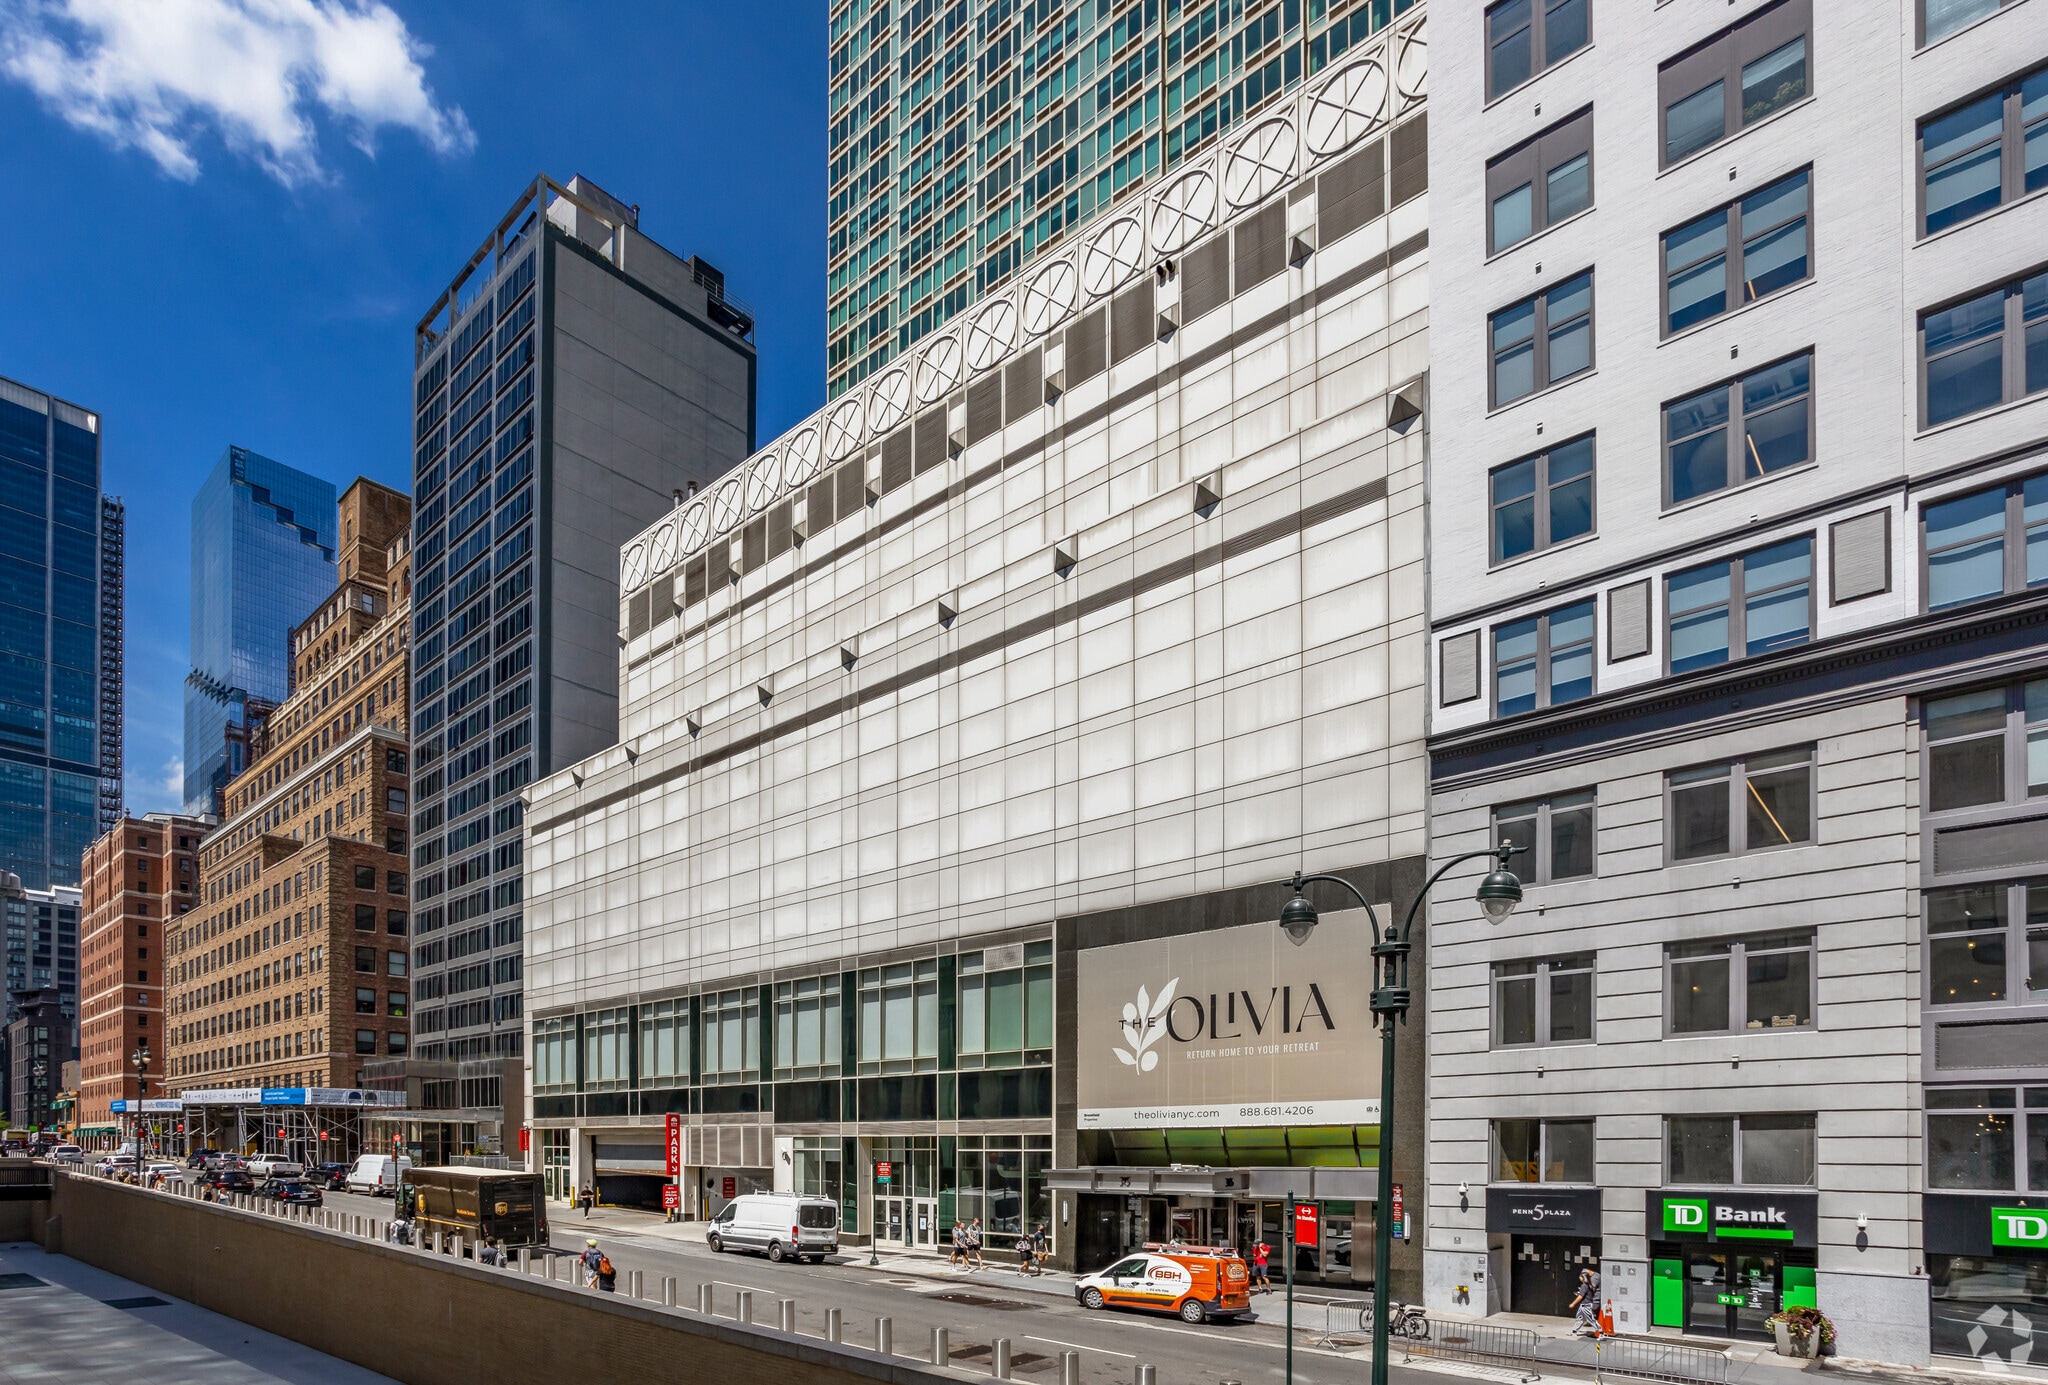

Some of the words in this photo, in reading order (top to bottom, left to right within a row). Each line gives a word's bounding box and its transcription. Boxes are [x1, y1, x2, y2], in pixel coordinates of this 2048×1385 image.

[1118, 1017, 1156, 1030] THE
[1166, 982, 1336, 1043] OLIVIA
[1186, 1049, 1217, 1060] RETURN
[1219, 1047, 1241, 1058] HOME
[1244, 1046, 1255, 1056] TO
[1257, 1044, 1280, 1055] YOUR
[1283, 1041, 1320, 1054] RETREAT
[1134, 1108, 1220, 1121] theolivianyc.com
[1239, 1104, 1315, 1118] 888.681.4206
[671, 1129, 679, 1163] PARK
[1301, 1215, 1317, 1223] Standing
[1532, 1203, 1545, 1221] 5
[1668, 1204, 1703, 1226] TD
[1715, 1206, 1786, 1224] Bank
[1998, 1215, 2048, 1240] TD
[1155, 1270, 1182, 1279] BBH
